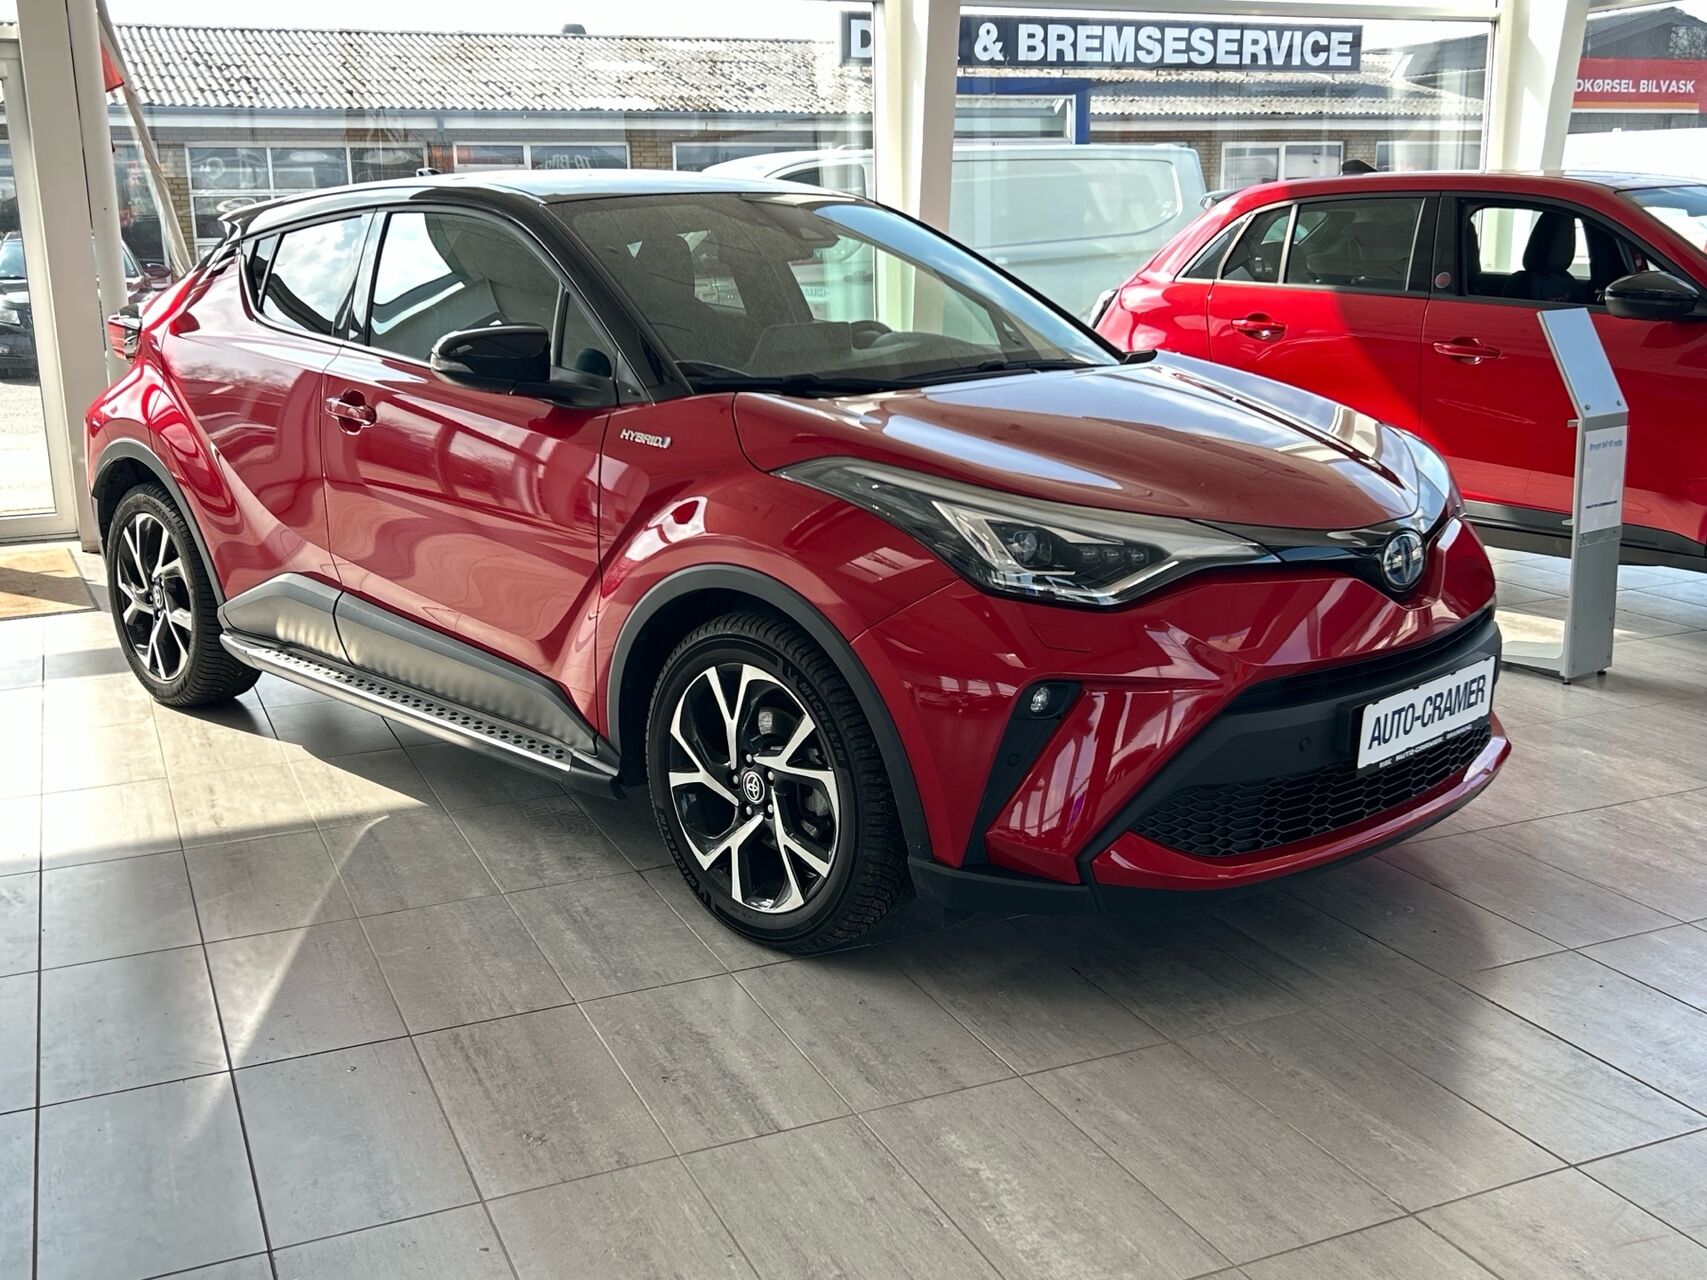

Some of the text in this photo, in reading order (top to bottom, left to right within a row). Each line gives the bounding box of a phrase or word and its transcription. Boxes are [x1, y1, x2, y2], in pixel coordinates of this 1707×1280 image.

[974, 22, 1352, 66] & BREMSESERVICE
[1639, 79, 1696, 94] BILVASK
[620, 428, 662, 448] HYBRID
[799, 681, 846, 761] MICHELIN
[1368, 674, 1486, 750] AUTO-CRAMER
